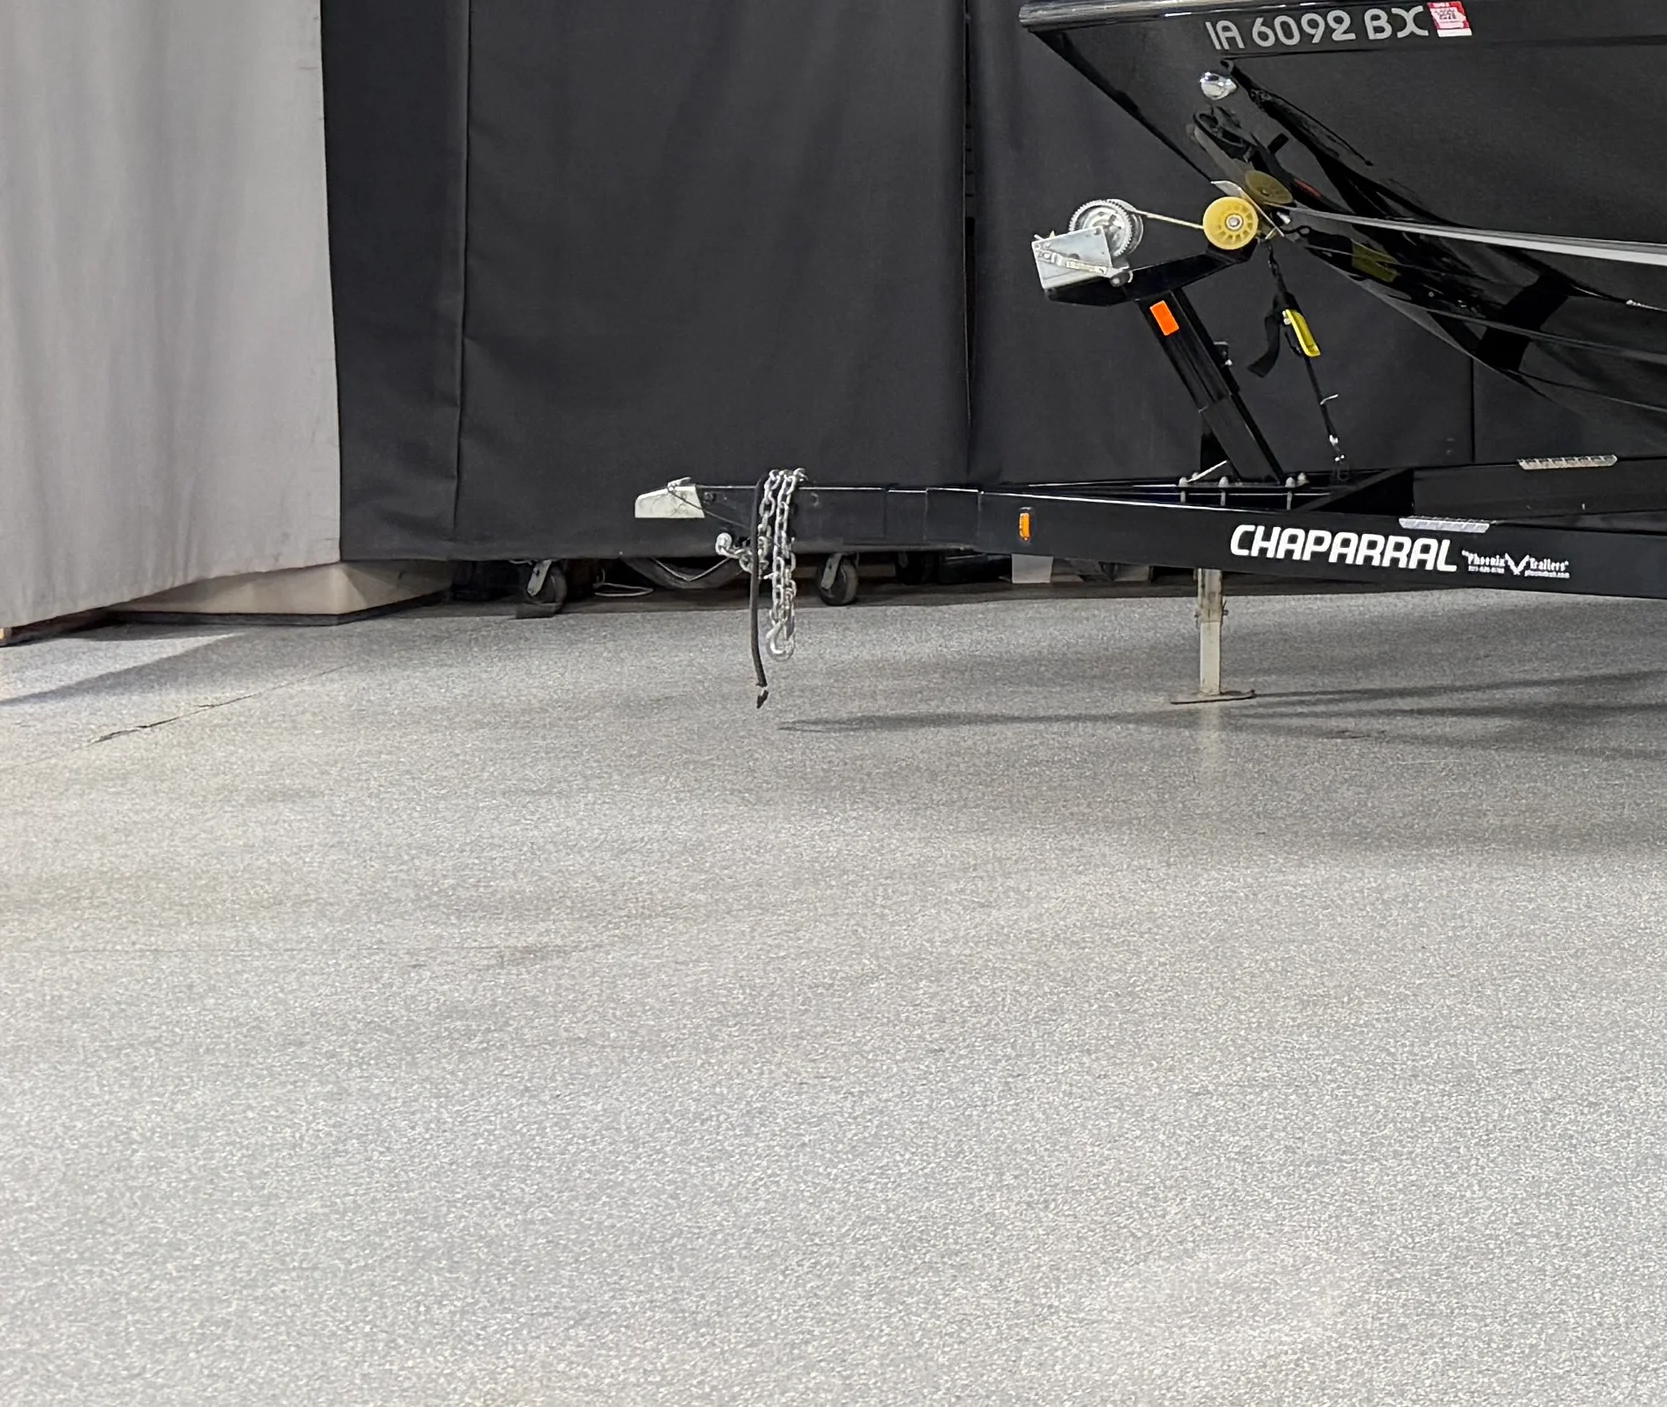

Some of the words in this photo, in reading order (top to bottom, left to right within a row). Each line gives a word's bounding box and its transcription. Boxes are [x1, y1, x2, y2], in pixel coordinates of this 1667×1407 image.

[1205, 20, 1245, 50] IA
[1252, 9, 1356, 47] 6092
[1363, 6, 1429, 40] BX
[1230, 524, 1457, 572] CHAPARRAL
